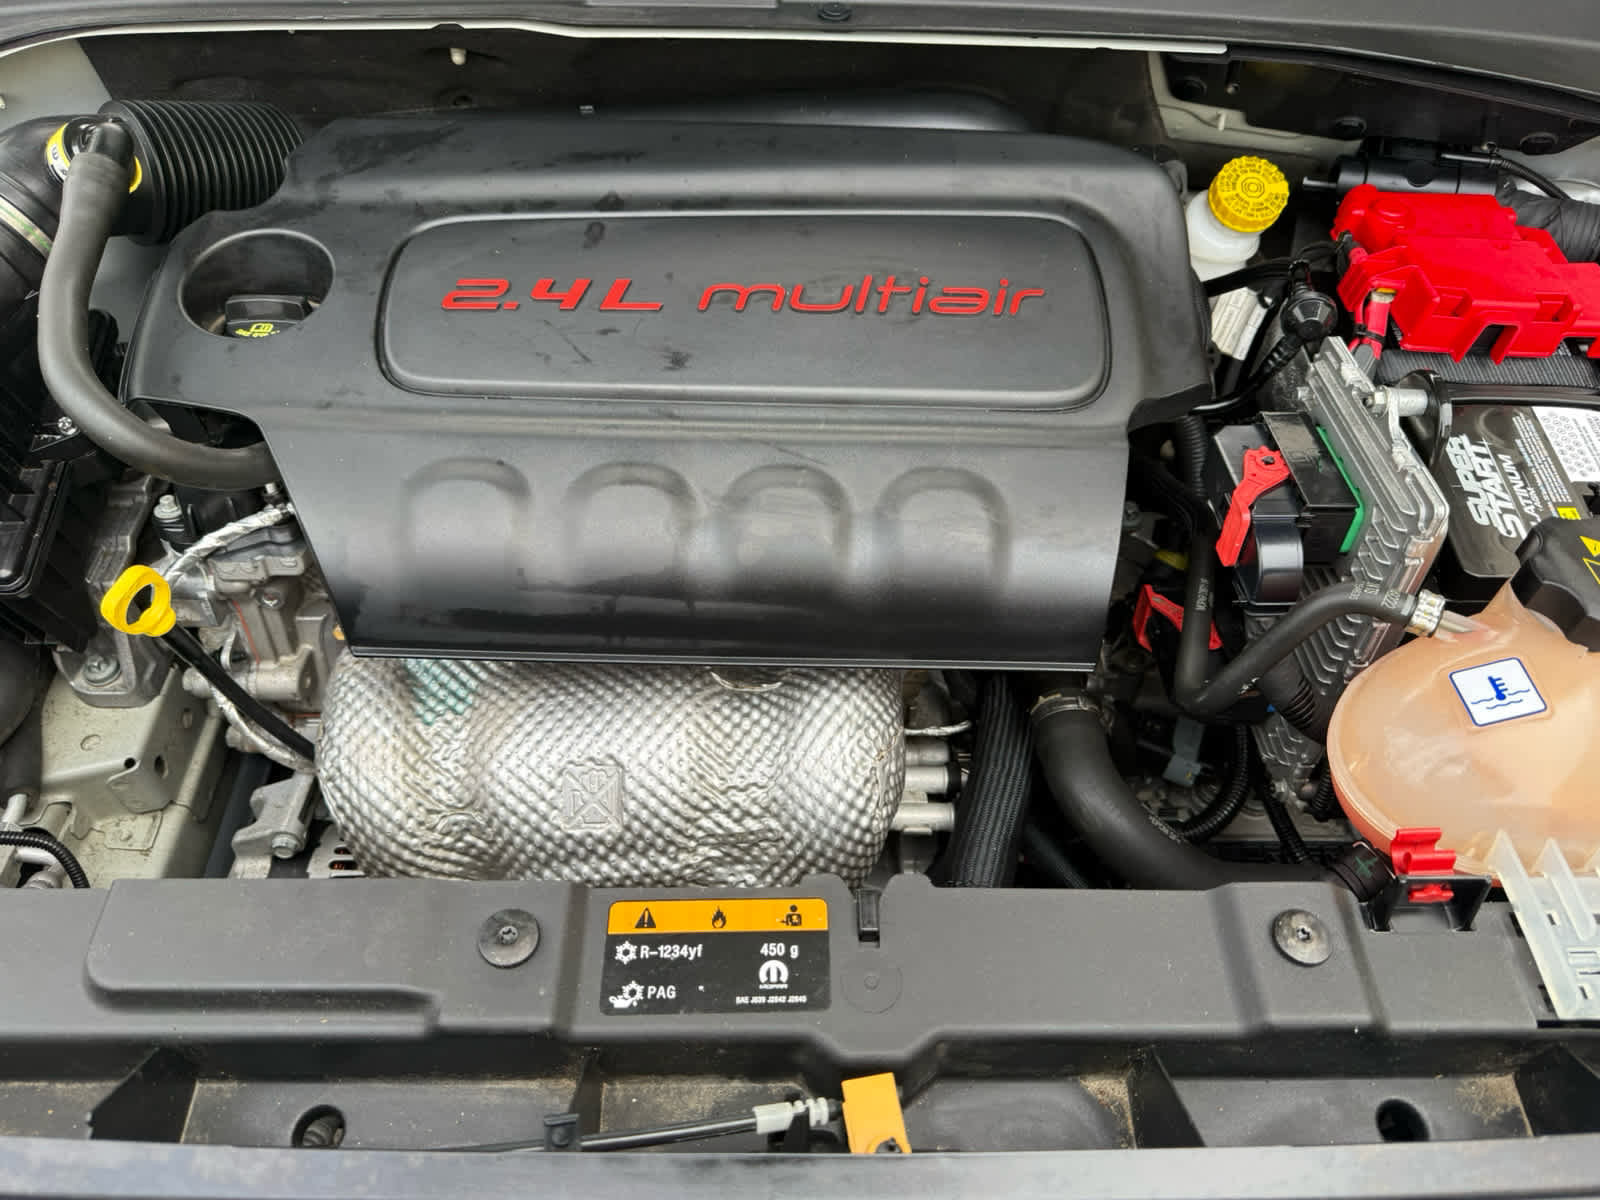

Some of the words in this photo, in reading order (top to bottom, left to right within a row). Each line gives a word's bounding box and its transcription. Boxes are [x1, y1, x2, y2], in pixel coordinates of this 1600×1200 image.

[441, 278, 663, 312] 2.4L
[697, 274, 1045, 315] multiair
[1446, 434, 1490, 526] SUPER
[1460, 433, 1527, 540] START
[640, 943, 703, 960] R-1234yf
[760, 943, 785, 957] 450
[790, 945, 799, 958] g
[647, 985, 676, 999] PAG
